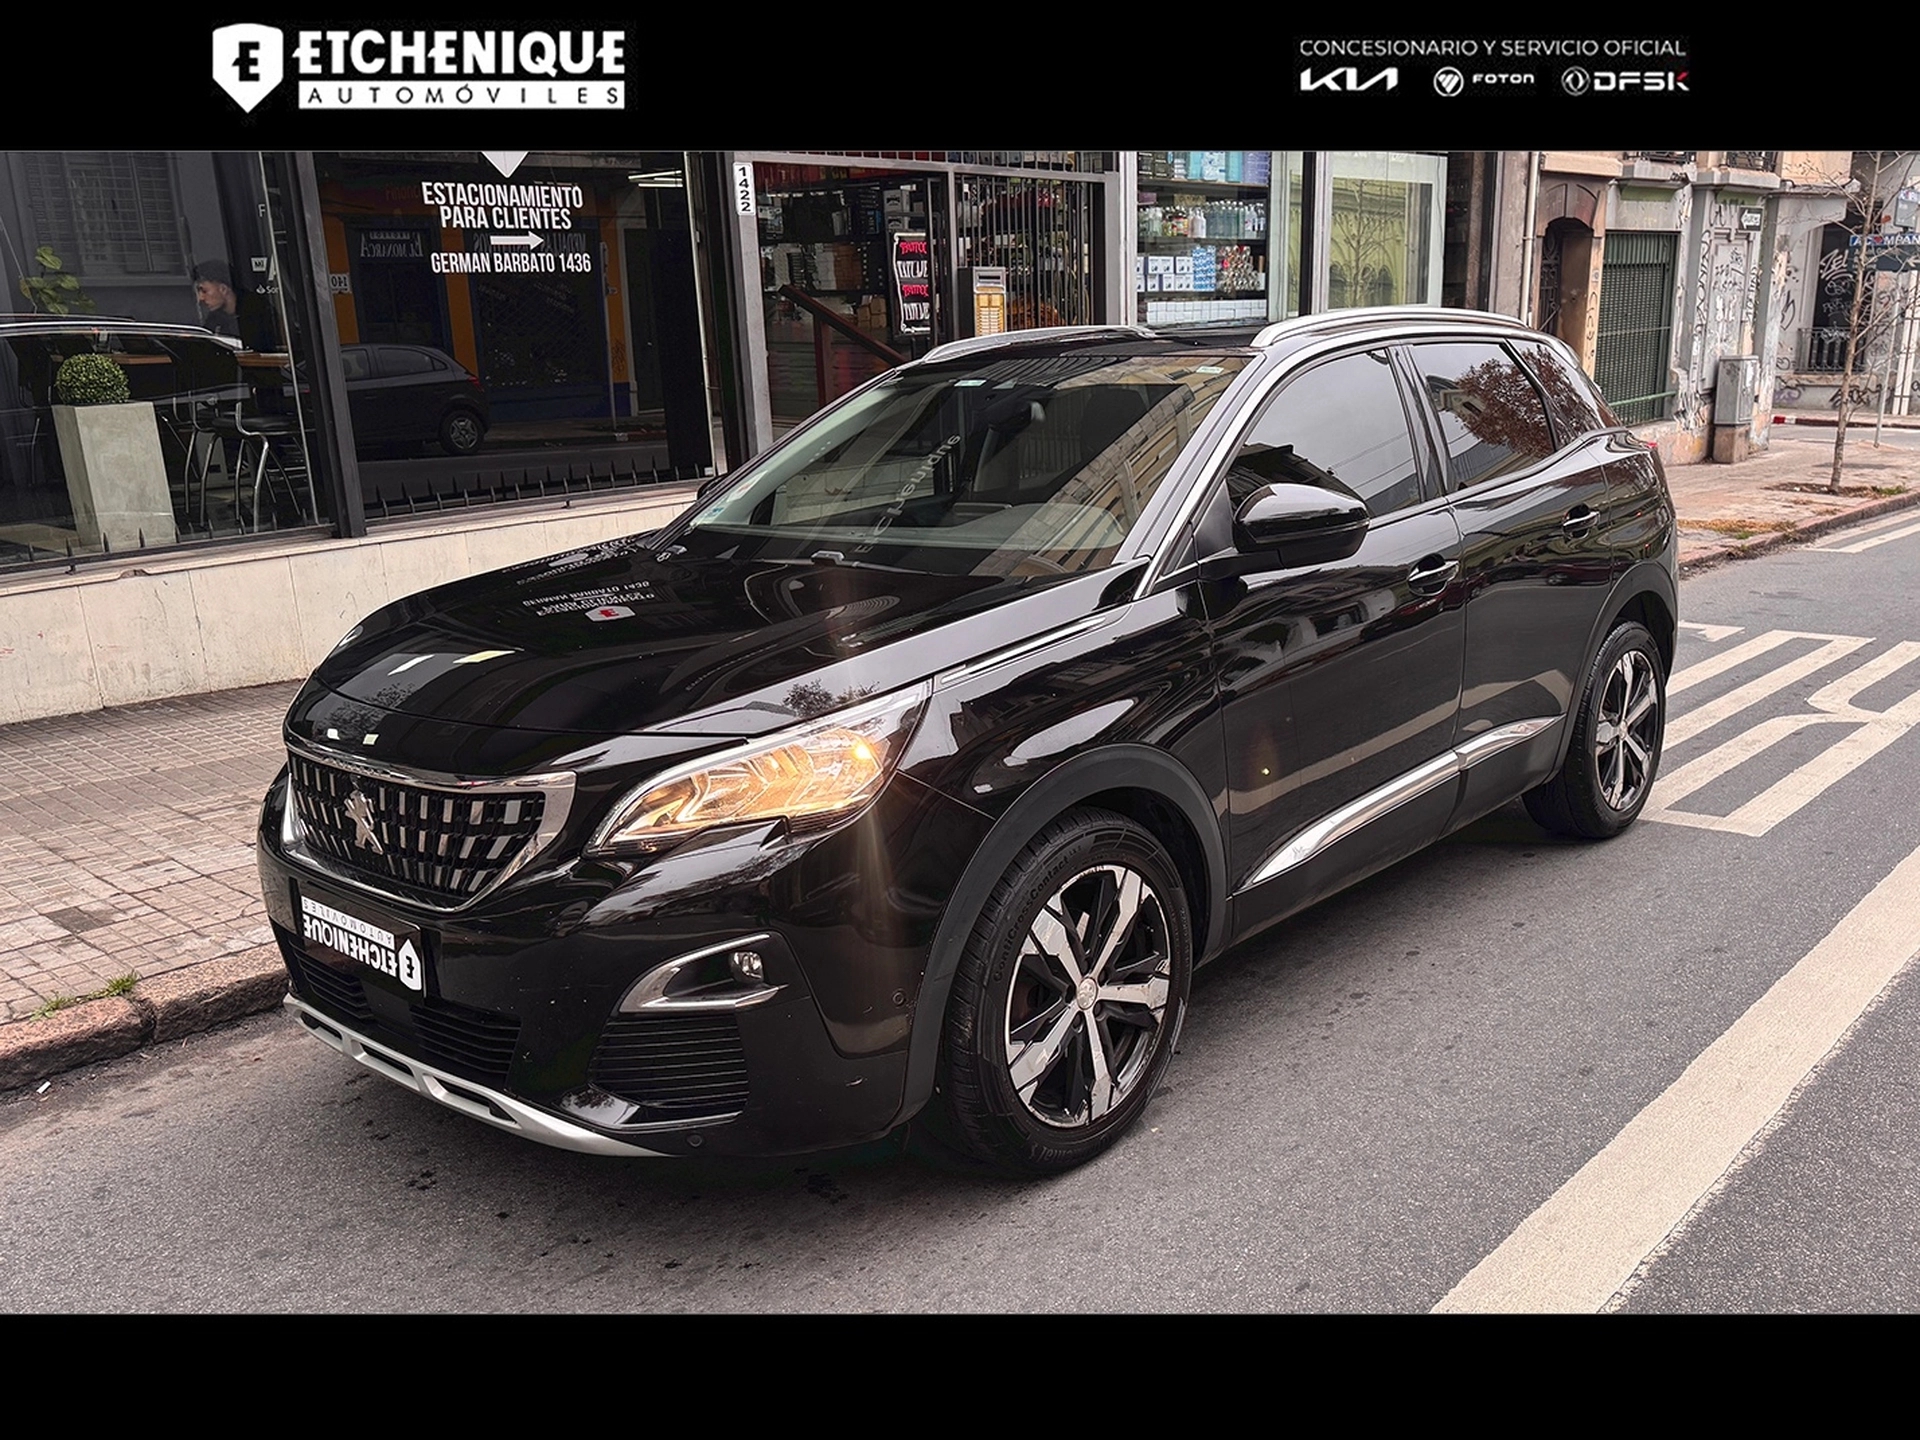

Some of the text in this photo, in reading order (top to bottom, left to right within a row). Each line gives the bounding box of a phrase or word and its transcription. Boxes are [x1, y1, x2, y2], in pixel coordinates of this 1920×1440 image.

[421, 181, 584, 209] ESTACIONAMIENTO
[738, 166, 751, 212] 1422
[439, 206, 572, 230] PARA CLIENTES
[431, 252, 592, 274] GERMAN BARBATO 1436
[303, 914, 397, 977] ETCHENIQUE
